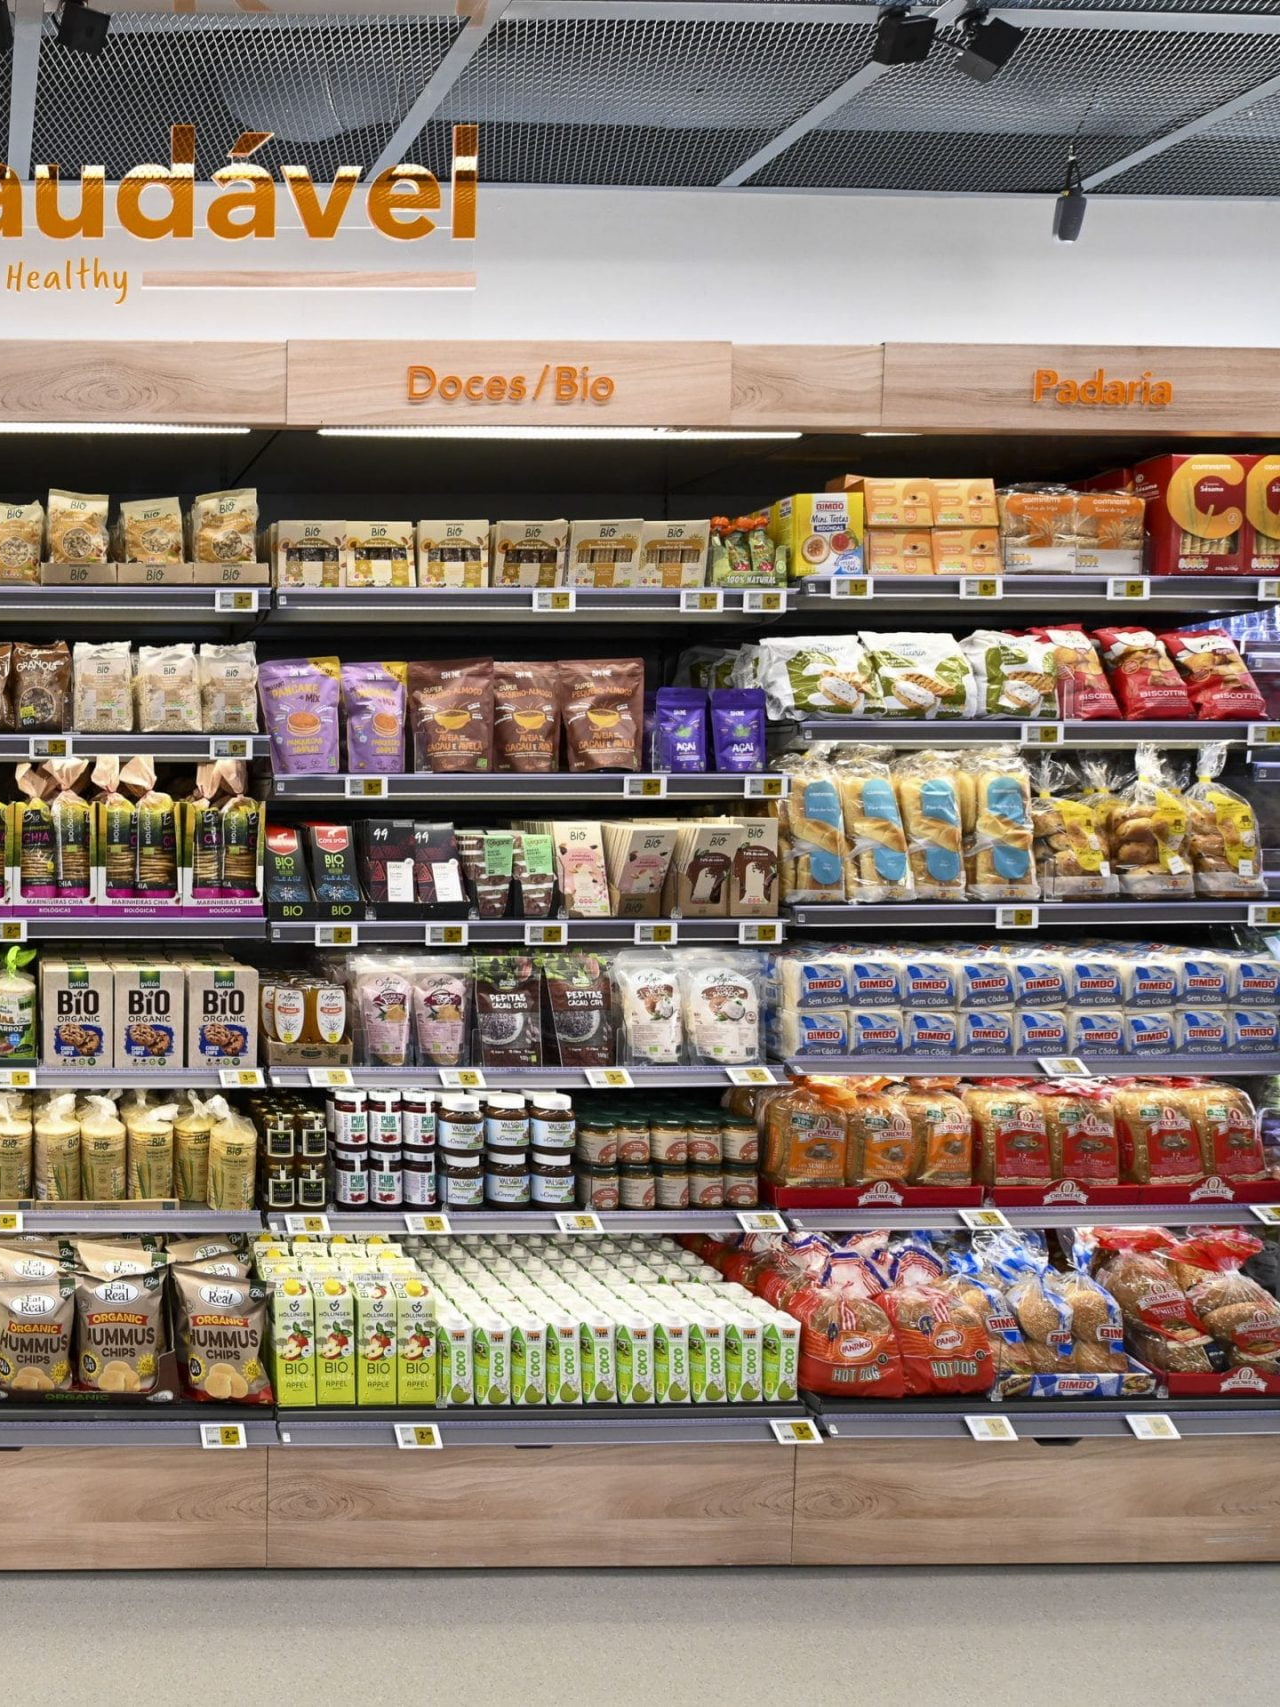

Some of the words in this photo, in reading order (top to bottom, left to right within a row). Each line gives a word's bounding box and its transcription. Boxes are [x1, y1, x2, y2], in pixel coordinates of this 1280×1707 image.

[6, 256, 128, 305] Healthy
[406, 365, 616, 403] Doces/Bio
[1032, 368, 1173, 405] Padaria
[816, 502, 844, 511] BIMBO
[811, 514, 825, 523] Mini
[827, 514, 848, 524] Tostas
[726, 576, 747, 584] 100%
[750, 576, 776, 584] NATURAL
[275, 857, 295, 867] BIO
[325, 855, 344, 864] BIO
[283, 906, 302, 916] BIO
[332, 905, 351, 915] BIO
[809, 980, 841, 989] BIMBO
[860, 980, 893, 988] BIMBO
[912, 981, 946, 989] BIMBO
[972, 979, 1005, 989] BIMBO
[1080, 980, 1114, 988] BIMBO
[1139, 981, 1172, 990] BIMBO
[1189, 978, 1221, 987] BIMBO
[1243, 980, 1275, 988] BIMBO
[489, 994, 525, 1002] PEPITAS
[566, 991, 602, 999] PEPITAS
[144, 1277, 159, 1286] Bio
[104, 1289, 129, 1300] Real
[21, 1301, 46, 1312] Real
[93, 1314, 143, 1324] ORGANIC
[196, 1316, 244, 1326] ORGANIC
[10, 1324, 59, 1334] ORGANIC
[0, 1333, 68, 1354] HUMMUS
[101, 1348, 135, 1357] CHIPS
[206, 1350, 240, 1360] CHIPS
[16, 1354, 50, 1364] CHIPS
[456, 1351, 466, 1377] COCO
[638, 1350, 647, 1375] COCO
[747, 1349, 756, 1374] COCO
[285, 1363, 308, 1374] BIO
[325, 1362, 348, 1373] BIO
[367, 1363, 390, 1374] BIO
[406, 1362, 429, 1374] BIO
[494, 1352, 504, 1378] COCO
[932, 1362, 953, 1377] HOT
[1058, 1380, 1094, 1390] BIMBO
